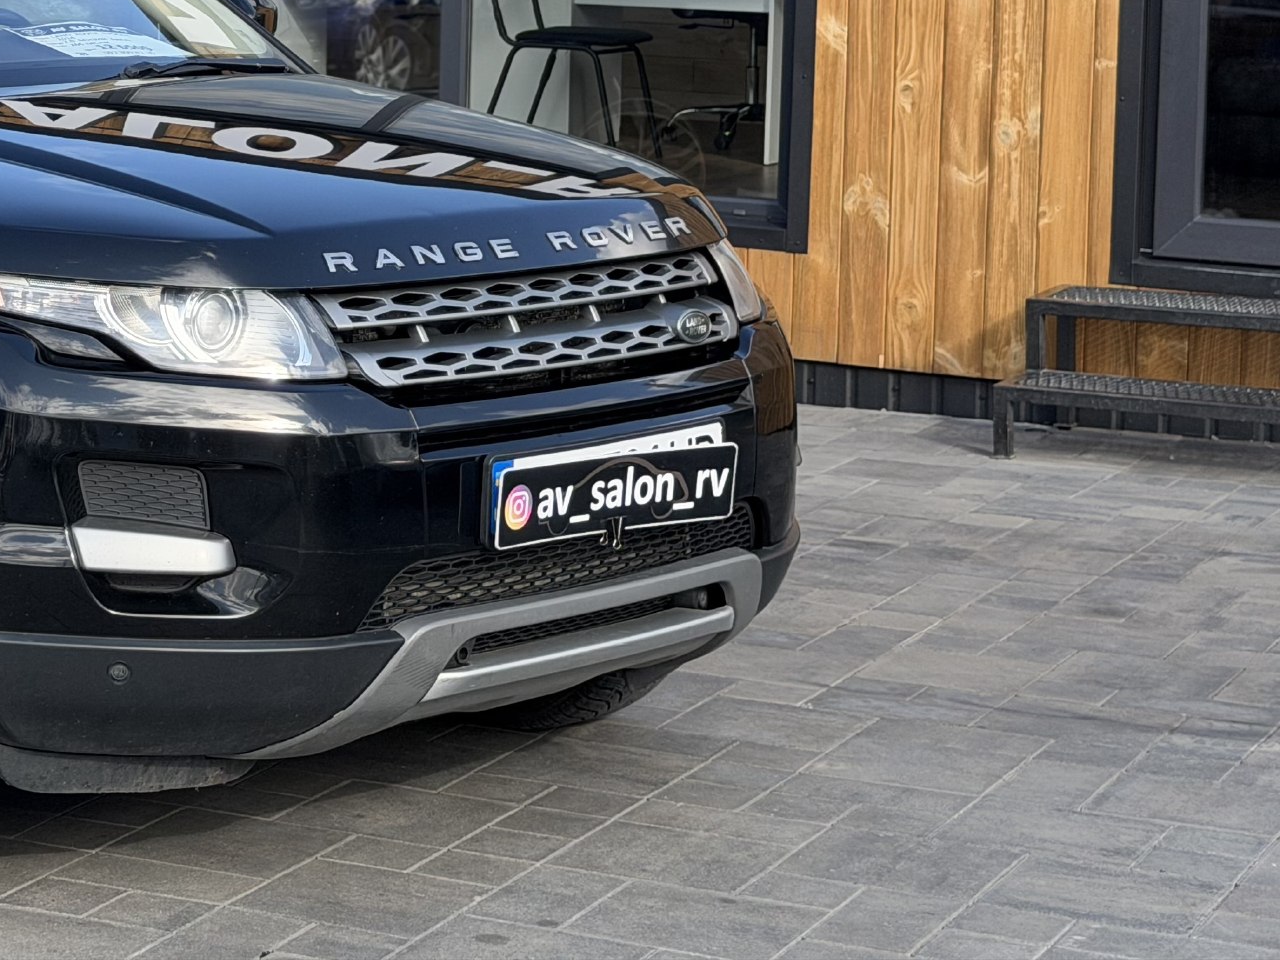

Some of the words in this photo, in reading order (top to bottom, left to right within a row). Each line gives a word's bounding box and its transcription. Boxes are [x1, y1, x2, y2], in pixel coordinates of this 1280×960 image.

[322, 238, 519, 273] RANGE
[546, 216, 692, 252] ROVER
[537, 465, 730, 524] av_salon_rv
